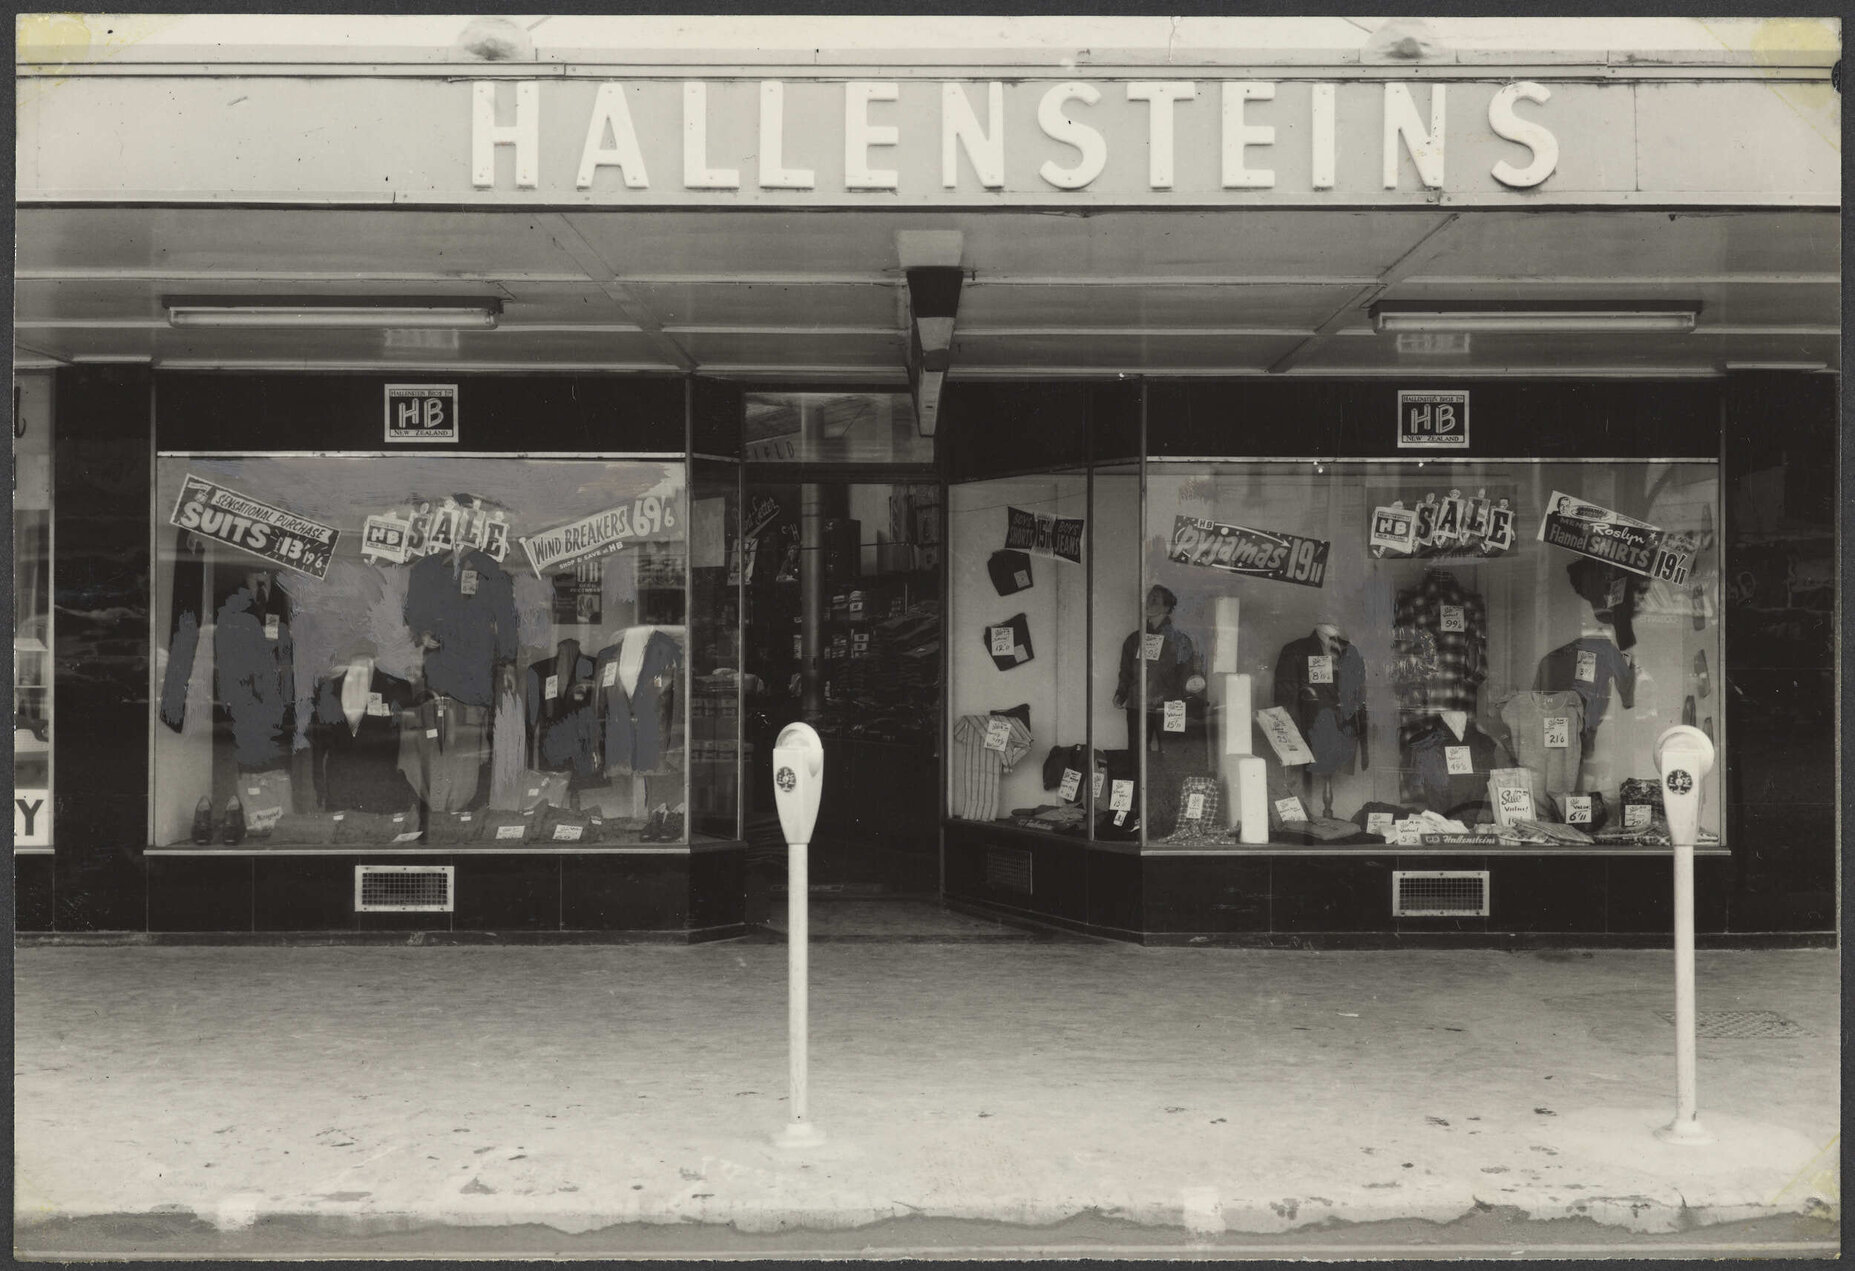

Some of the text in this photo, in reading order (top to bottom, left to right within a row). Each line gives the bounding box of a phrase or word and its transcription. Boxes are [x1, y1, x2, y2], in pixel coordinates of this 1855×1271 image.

[471, 81, 1560, 190] HALLENSTEINS
[398, 397, 444, 429] HB
[1410, 403, 1456, 434] HB
[180, 501, 271, 549] SUITS
[215, 493, 327, 540] SENSATIONAL PURCHASE
[407, 509, 506, 558] SALE
[564, 508, 627, 553] BREAKERS
[1200, 519, 1213, 528] HB
[1379, 518, 1407, 535] HB
[1416, 499, 1510, 545] SALE
[1590, 522, 1645, 546] Roslyn
[559, 559, 575, 570] SHOP
[584, 551, 601, 560] SAVE
[608, 541, 624, 552] HB
[1054, 534, 1080, 556] JEANS
[1549, 524, 1589, 551] Flannel
[1588, 536, 1652, 568] SHIRTS
[14, 798, 45, 837] Y
[1442, 834, 1496, 846] Hallensteins
